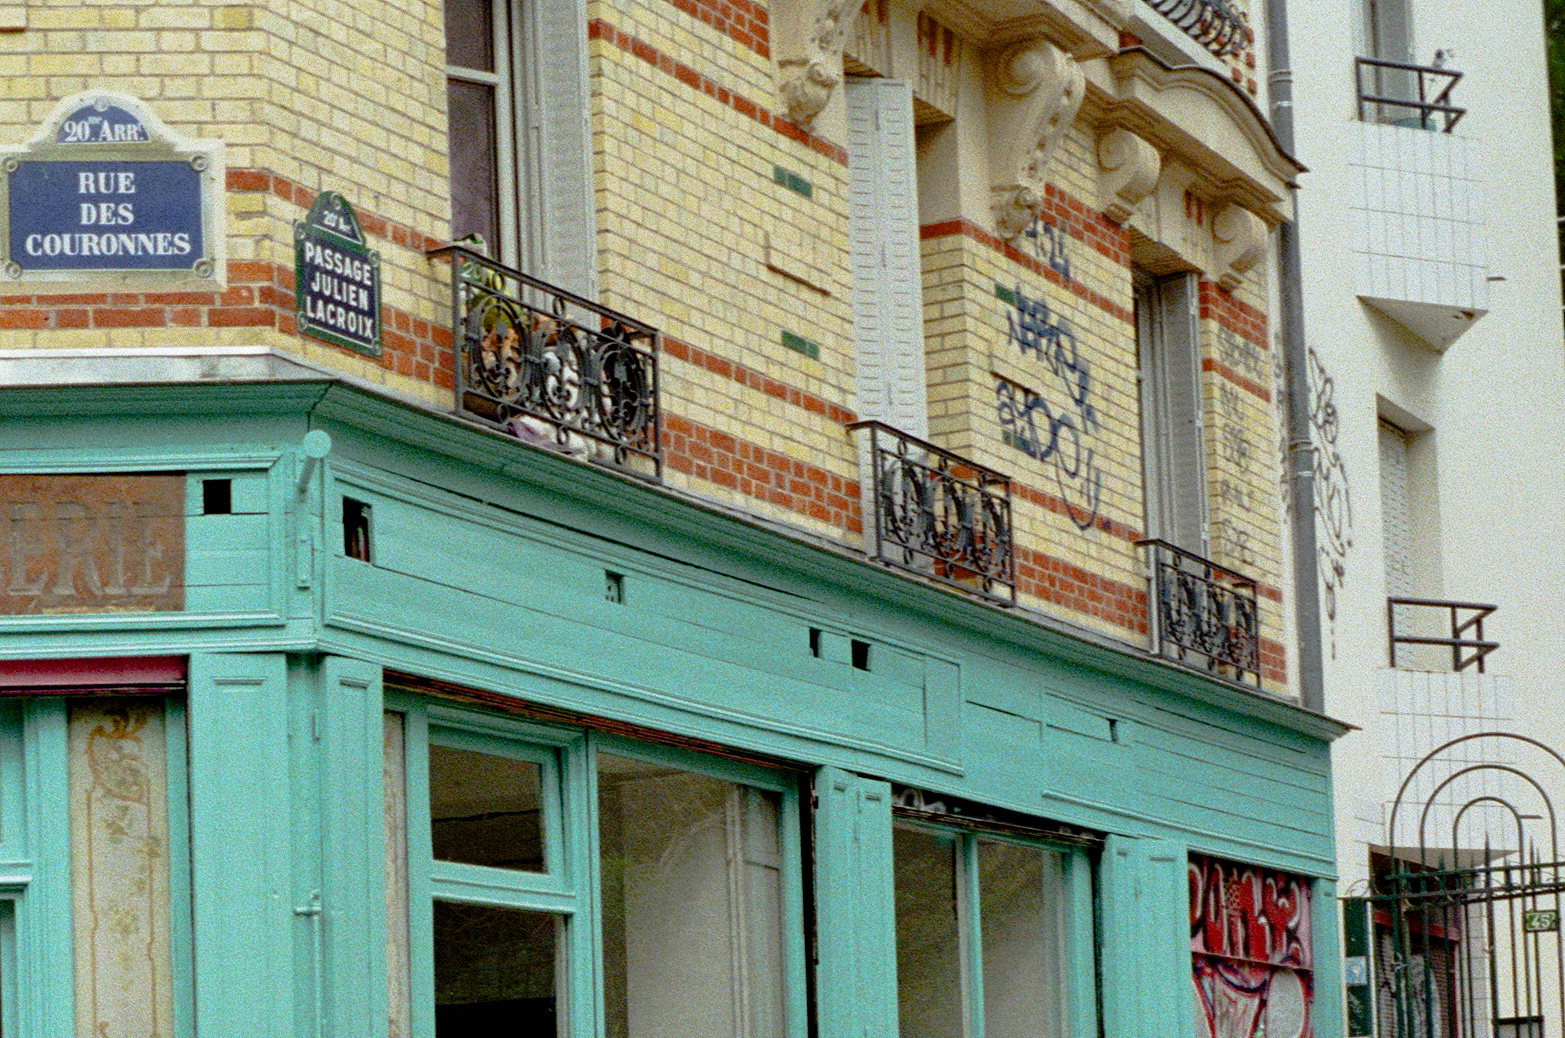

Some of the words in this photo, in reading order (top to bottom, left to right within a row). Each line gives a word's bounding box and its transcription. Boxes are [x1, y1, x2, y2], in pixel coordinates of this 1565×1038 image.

[78, 172, 135, 194] RUE
[80, 203, 134, 225] DES
[25, 232, 191, 256] COURONNES
[304, 241, 373, 286] PASSAGE
[311, 271, 369, 311] JULIEN
[305, 295, 374, 339] LACROIX
